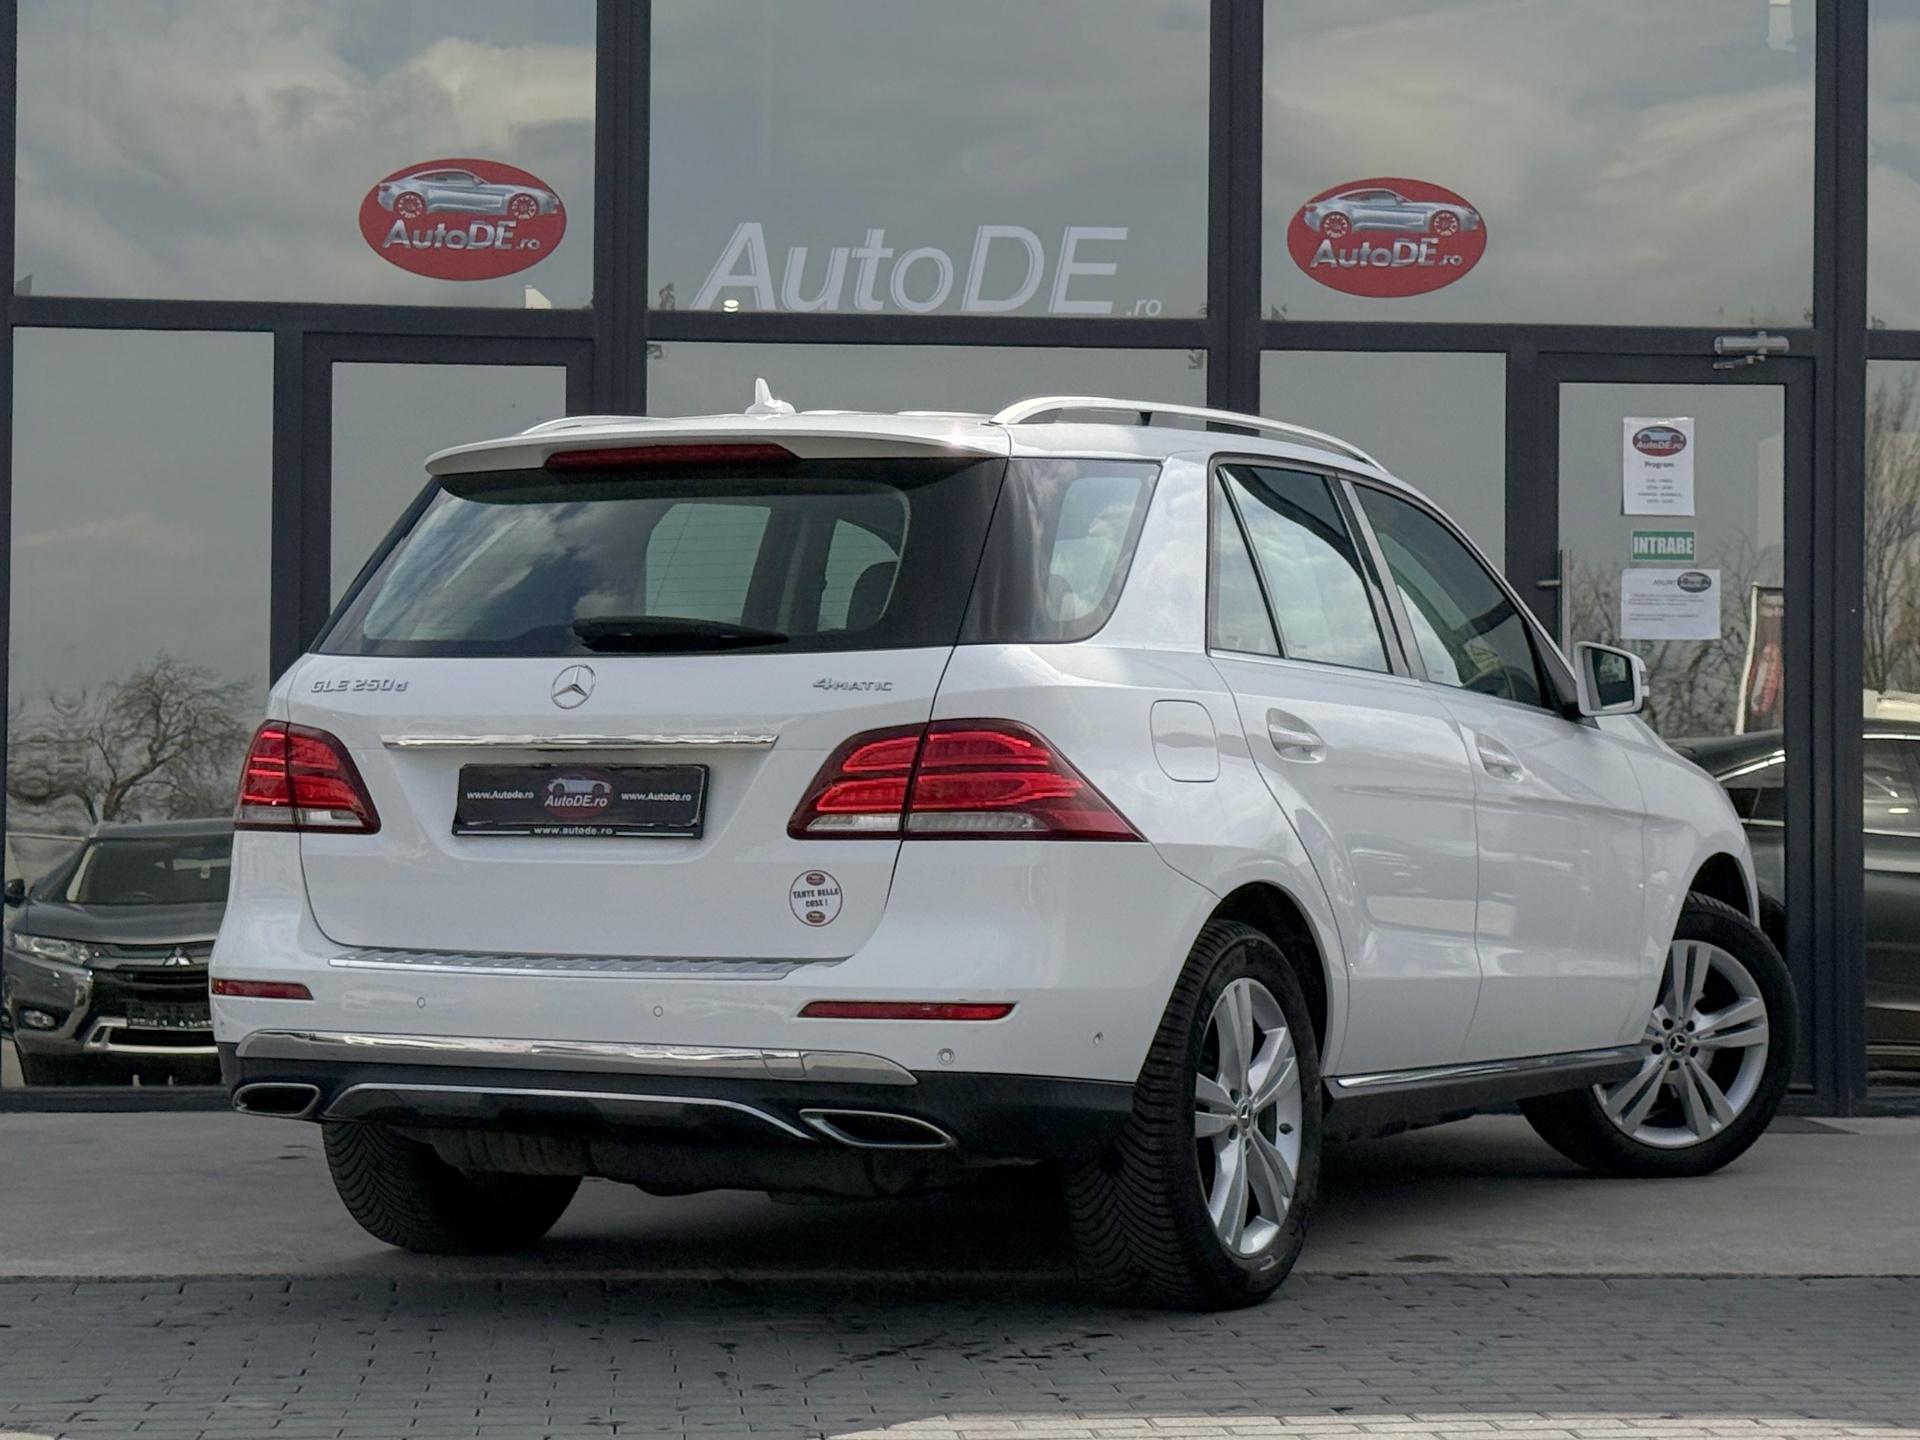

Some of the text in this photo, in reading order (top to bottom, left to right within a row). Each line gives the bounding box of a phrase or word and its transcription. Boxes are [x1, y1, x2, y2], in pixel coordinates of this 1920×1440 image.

[1633, 536, 1694, 554] INTRARE
[310, 679, 350, 693] GLE
[812, 678, 894, 691] 4MATIC
[466, 788, 535, 799] www.Autode.ro
[621, 791, 692, 802] www.Autode.ro
[544, 794, 608, 808] AutoDE.ro
